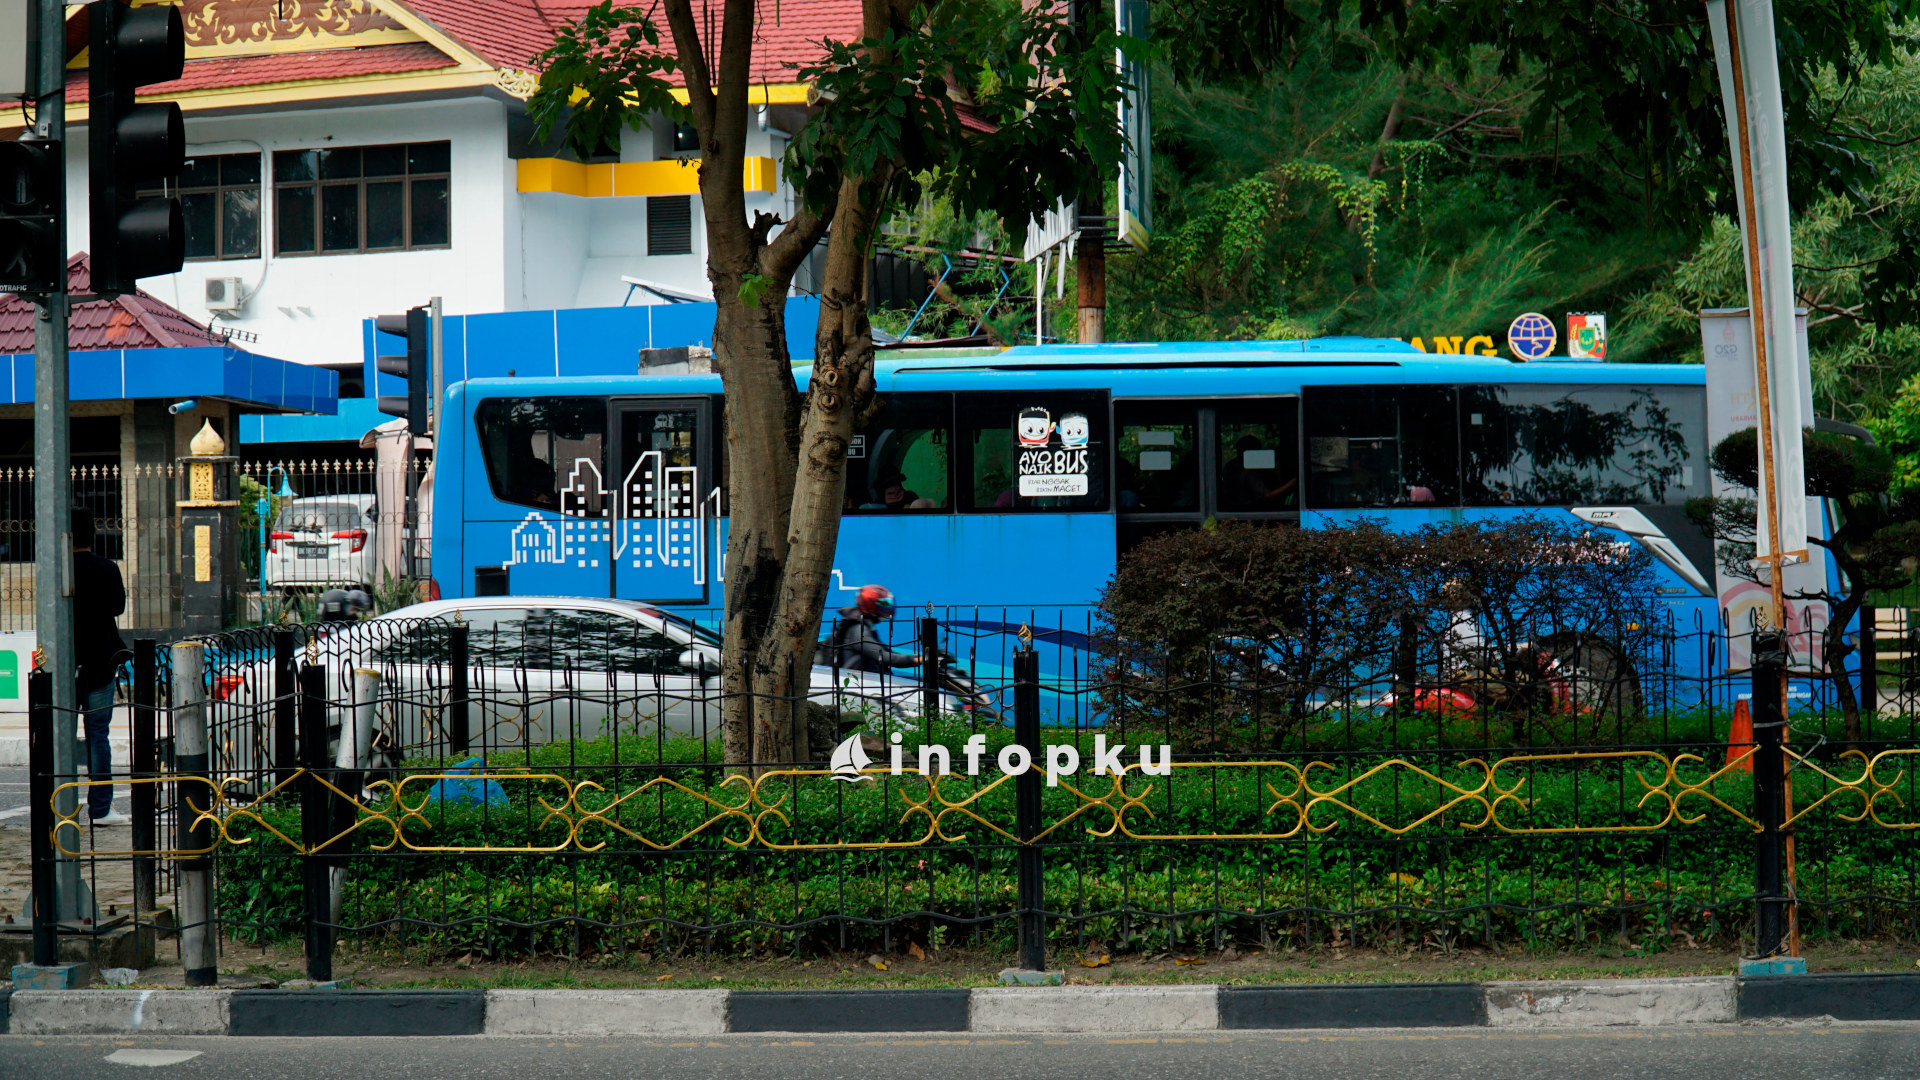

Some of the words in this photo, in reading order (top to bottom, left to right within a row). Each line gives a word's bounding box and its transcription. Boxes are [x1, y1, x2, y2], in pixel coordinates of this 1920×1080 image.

[1397, 335, 1499, 357] ANG
[1019, 450, 1052, 464] AYO
[1054, 449, 1089, 474] BUS
[1019, 463, 1053, 475] NAIK
[1053, 484, 1081, 493] MACET
